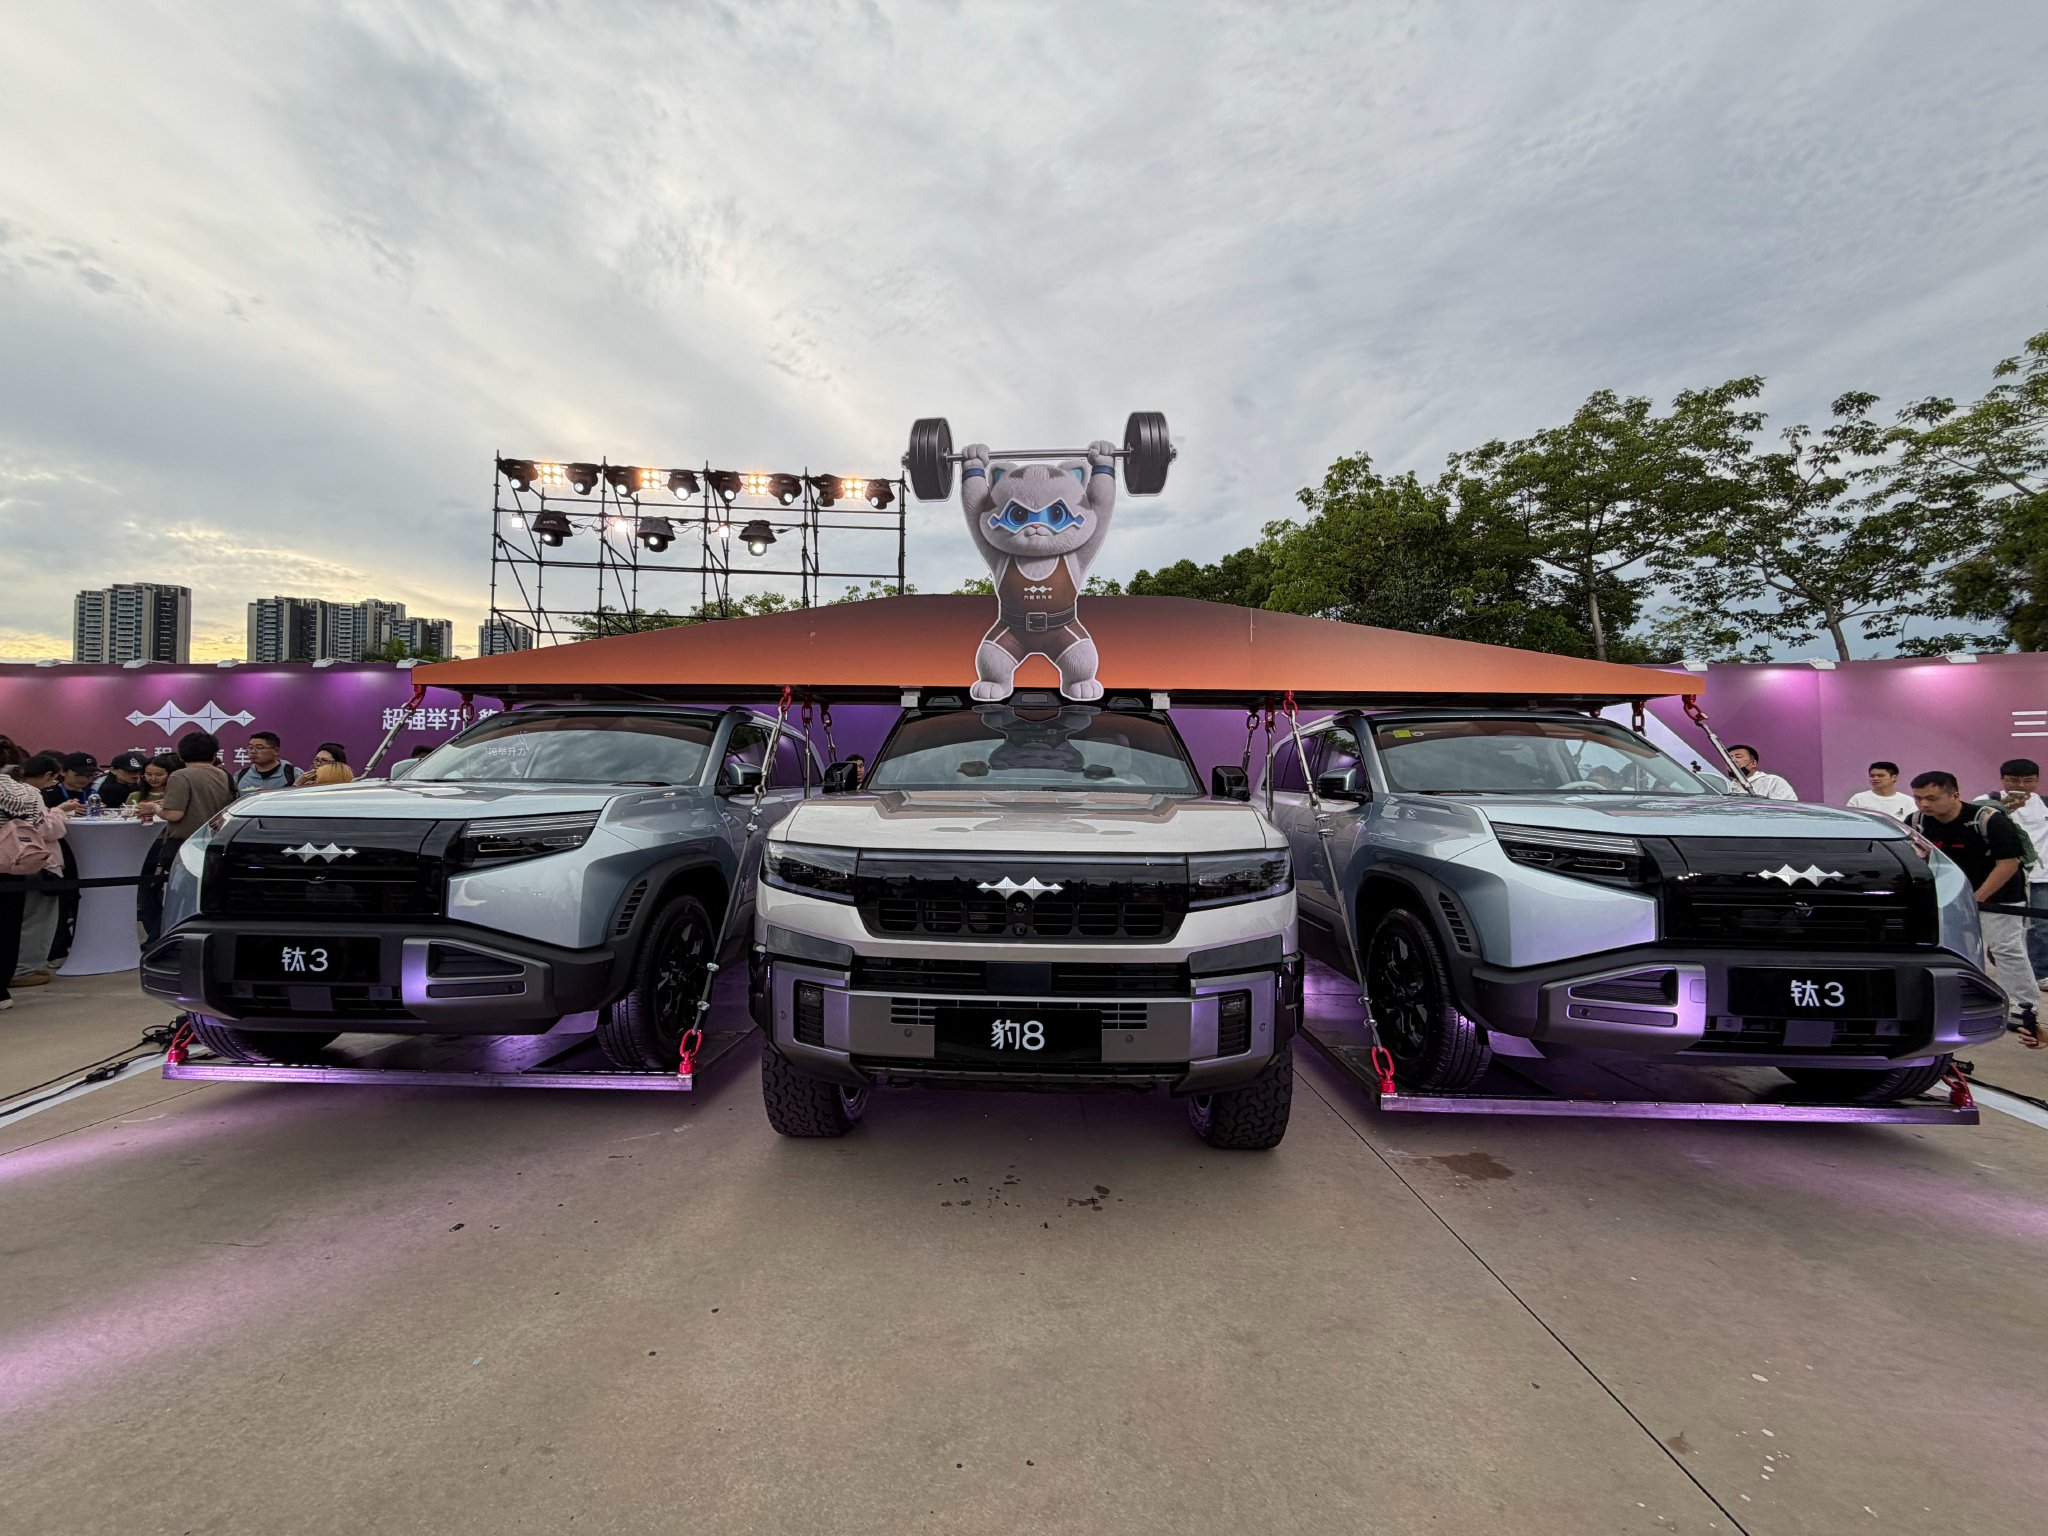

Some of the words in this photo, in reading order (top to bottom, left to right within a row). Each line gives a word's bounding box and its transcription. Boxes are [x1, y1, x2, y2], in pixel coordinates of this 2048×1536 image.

[281, 946, 329, 972] 钛3
[1790, 979, 1845, 1007] 钛3
[990, 1019, 1045, 1051] 豹8
